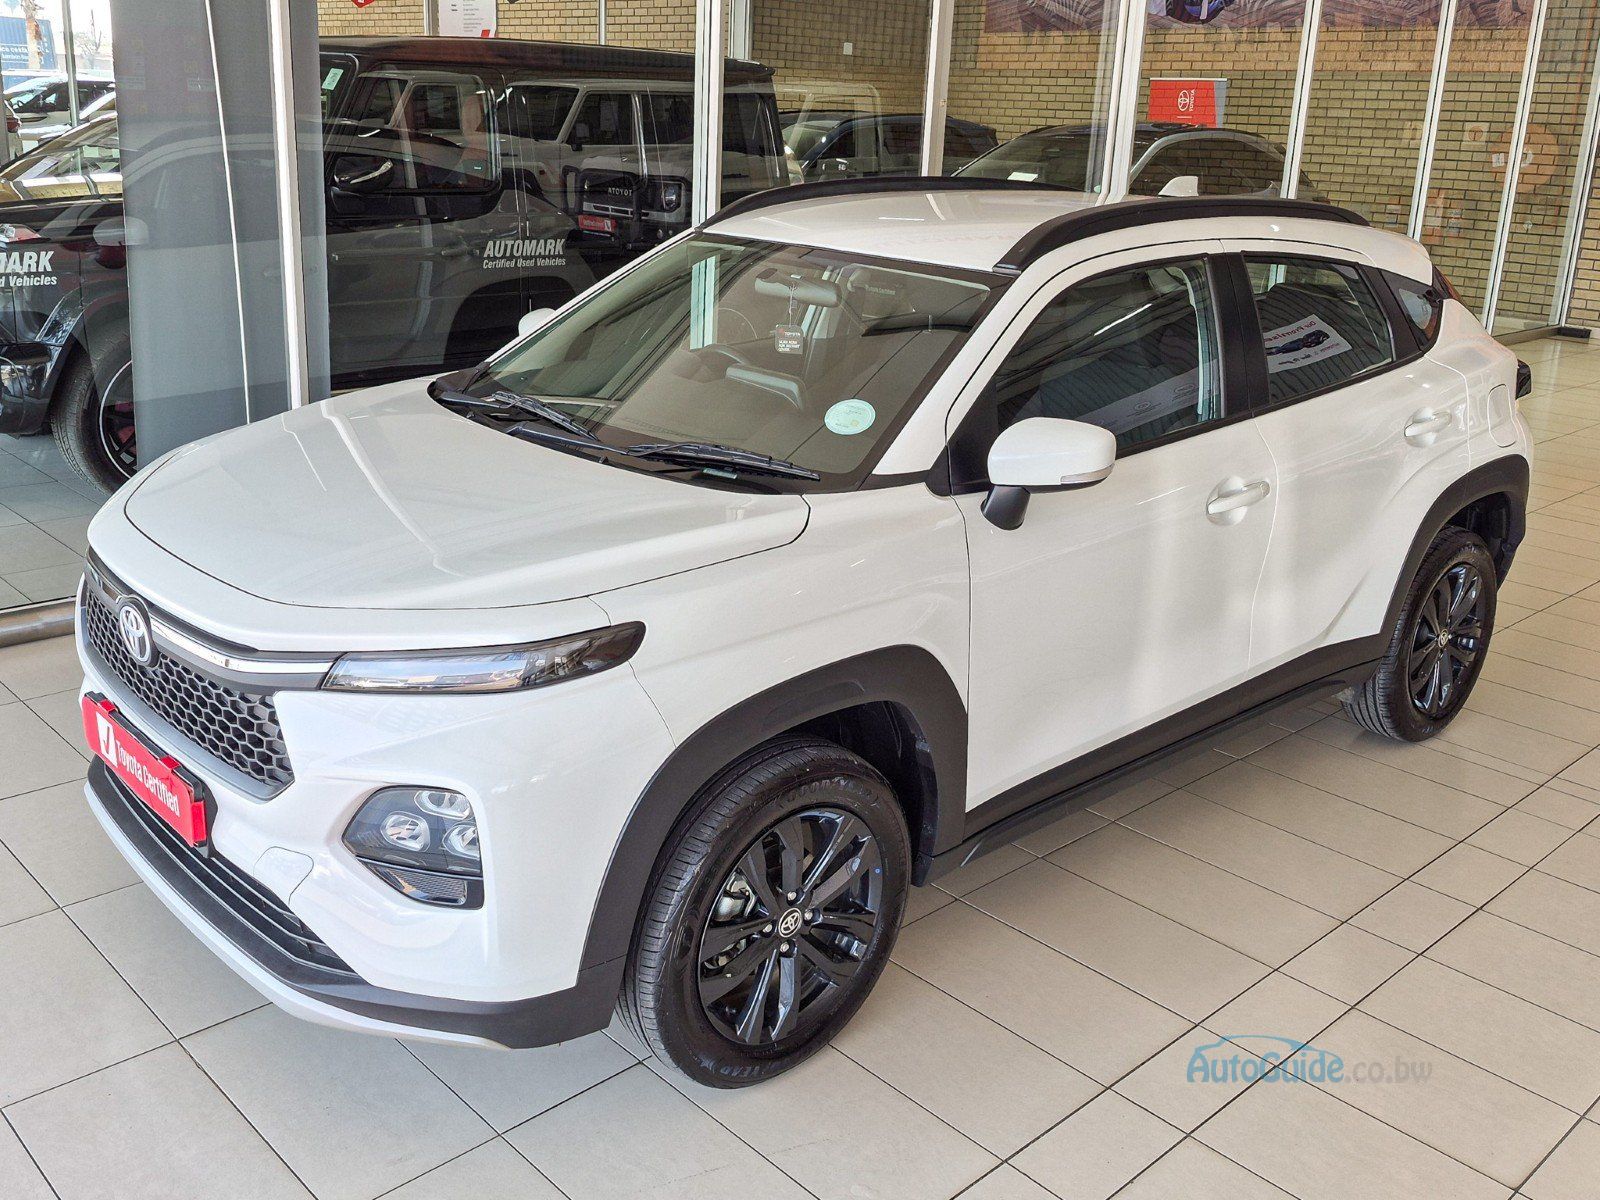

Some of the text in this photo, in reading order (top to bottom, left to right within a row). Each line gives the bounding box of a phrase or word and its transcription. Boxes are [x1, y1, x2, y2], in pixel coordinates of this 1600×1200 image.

[483, 239, 566, 258] AUTOMARK
[483, 257, 566, 269] Certified Used Vehicles
[9, 274, 58, 287] Vehicles
[116, 740, 181, 818] Toyota Certified
